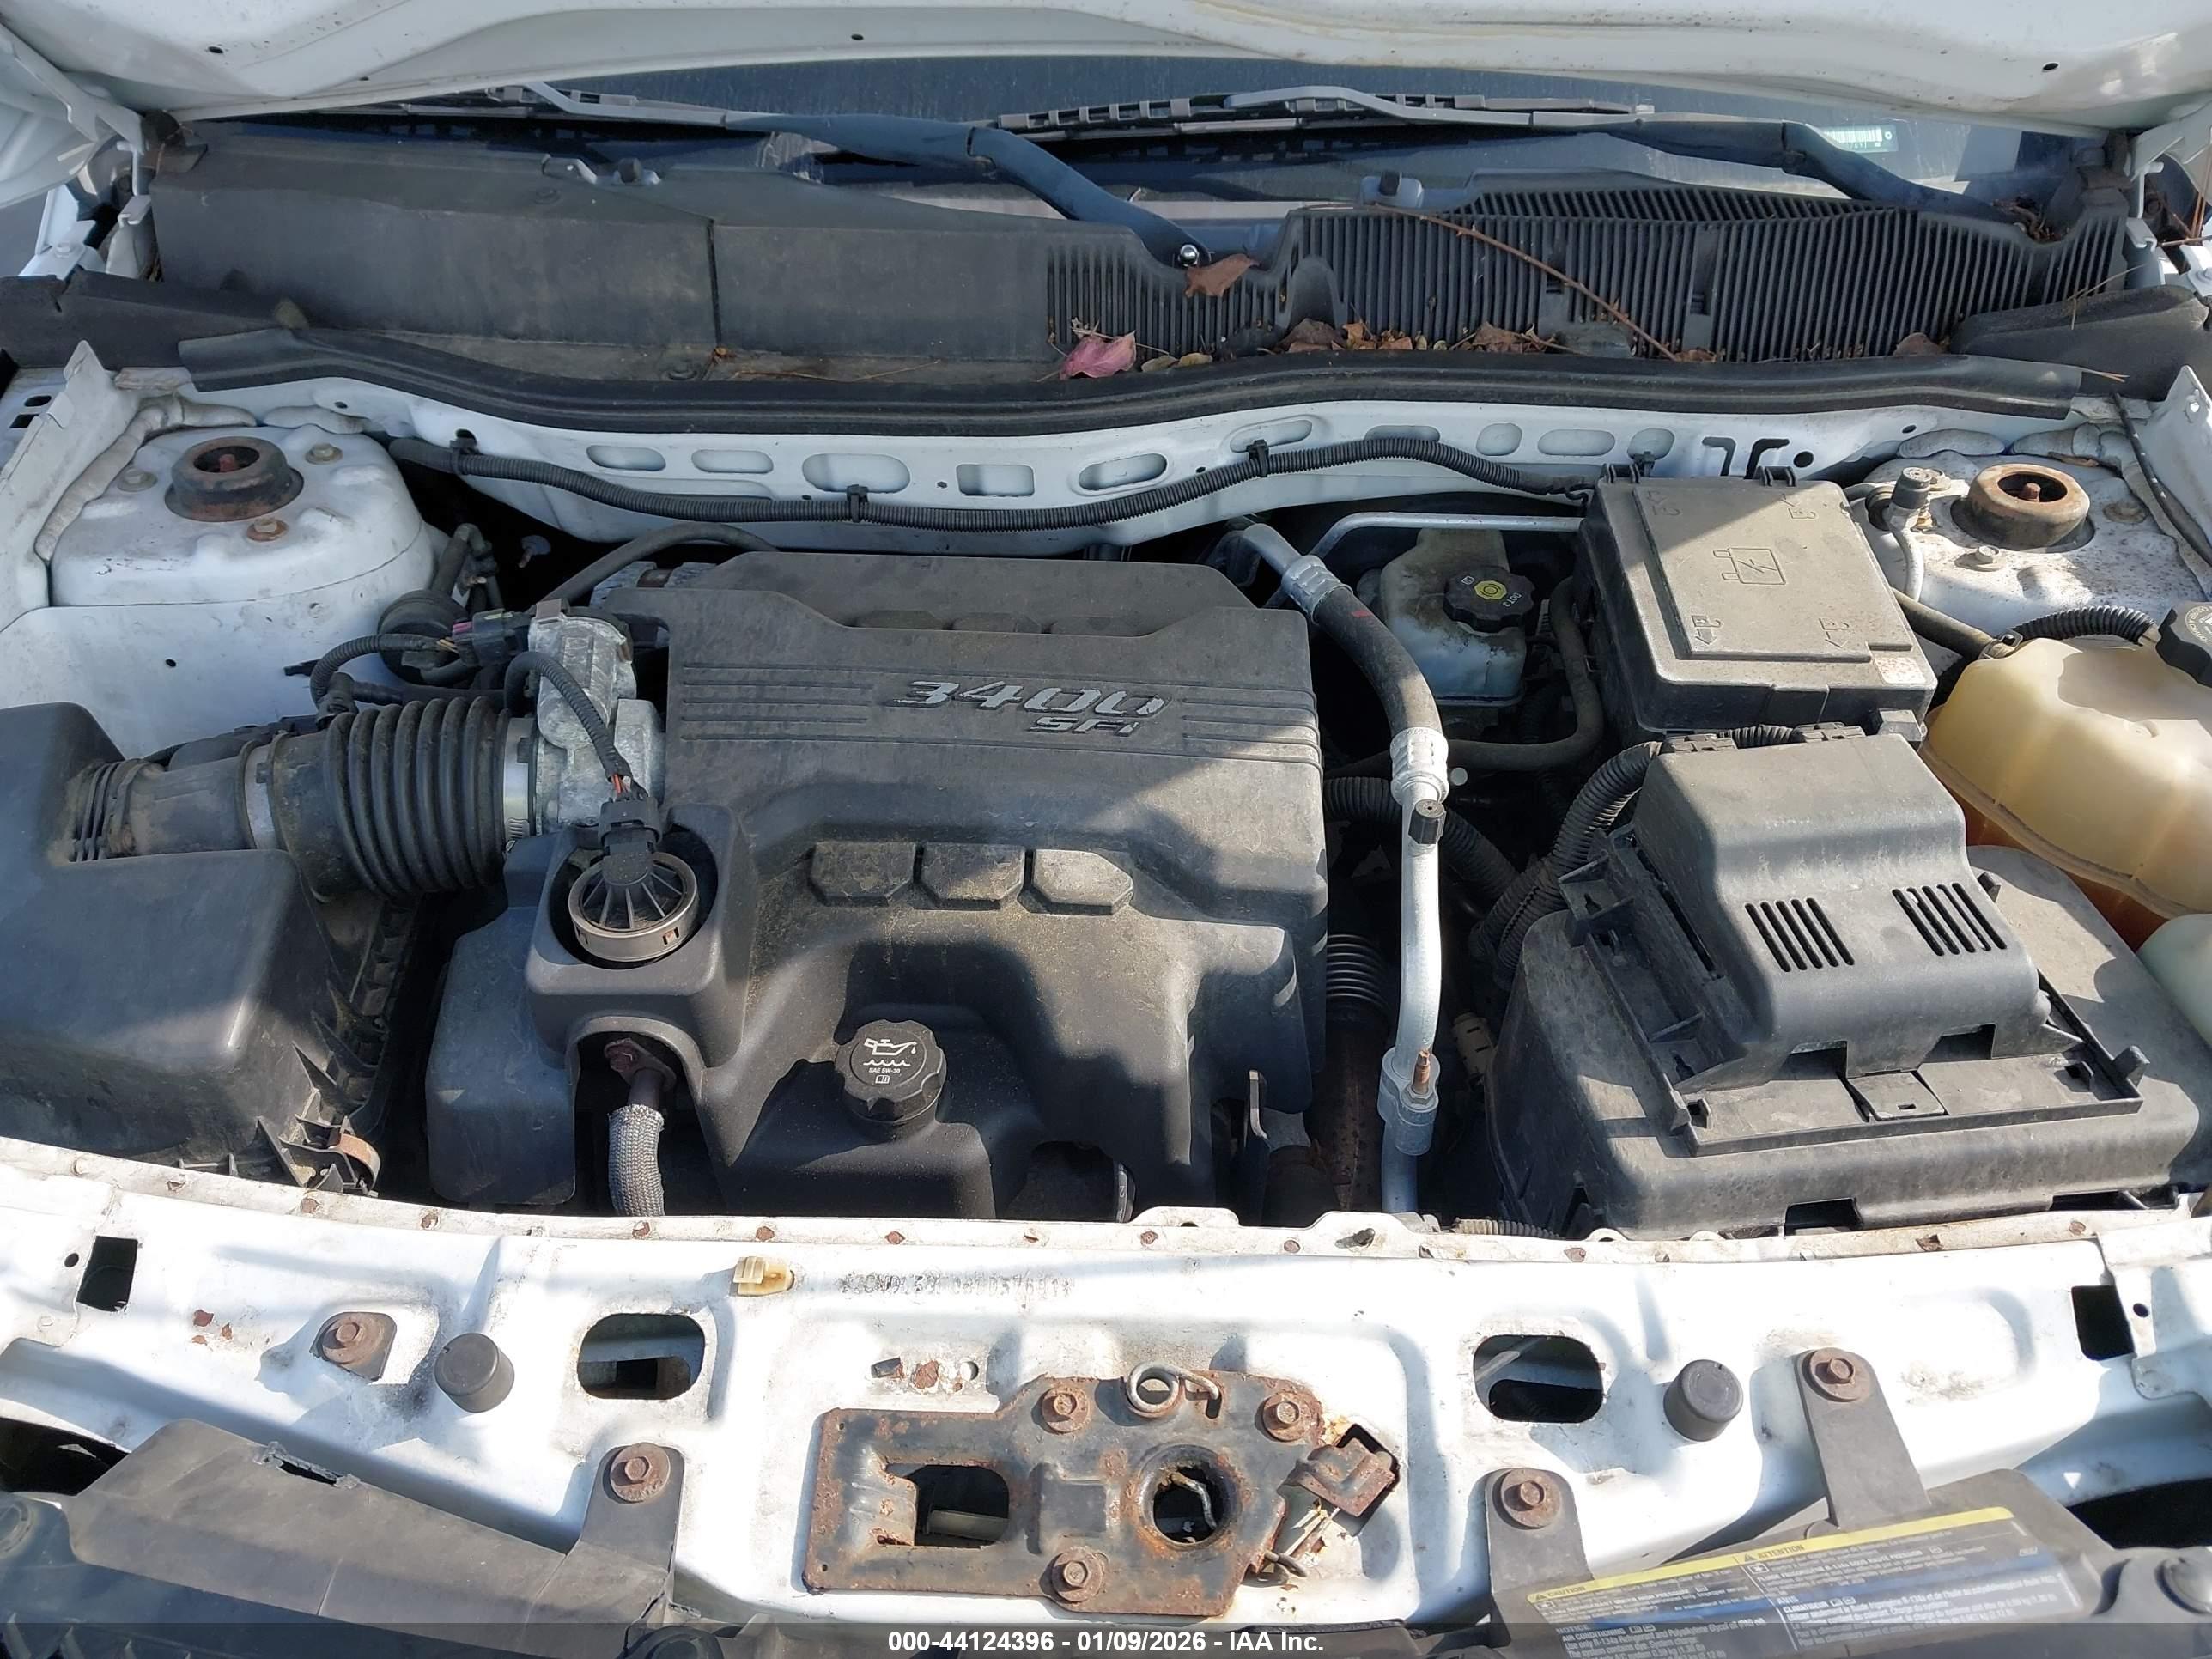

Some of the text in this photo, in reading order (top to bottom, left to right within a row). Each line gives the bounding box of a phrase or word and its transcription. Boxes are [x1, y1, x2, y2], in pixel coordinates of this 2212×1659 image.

[890, 680, 1168, 718] 3400
[1757, 1544, 1804, 1559] ATTENTION
[1547, 1585, 1585, 1597] CAUTION
